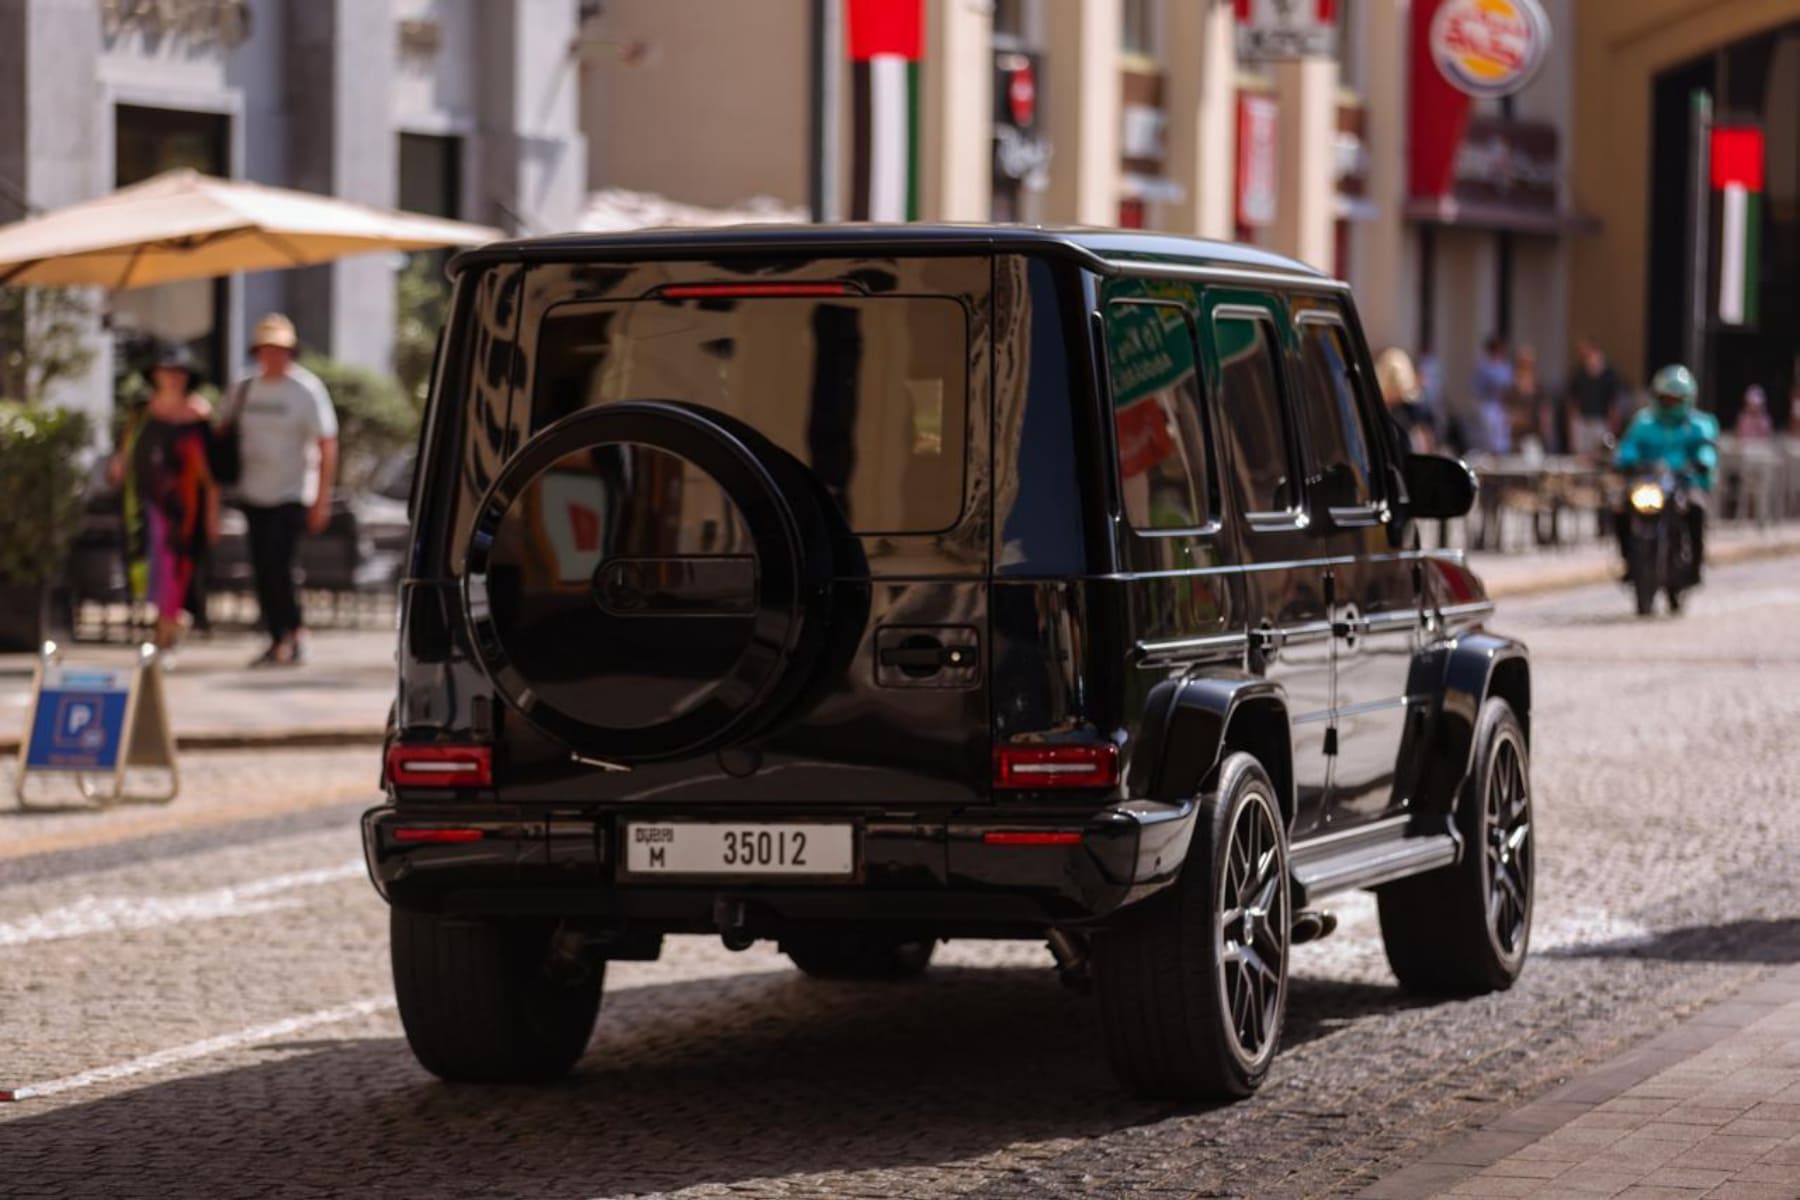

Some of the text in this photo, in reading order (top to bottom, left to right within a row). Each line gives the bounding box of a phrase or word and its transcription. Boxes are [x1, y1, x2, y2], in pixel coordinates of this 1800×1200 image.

[69, 704, 91, 734] P
[650, 847, 665, 868] M
[723, 831, 807, 866] 35012
